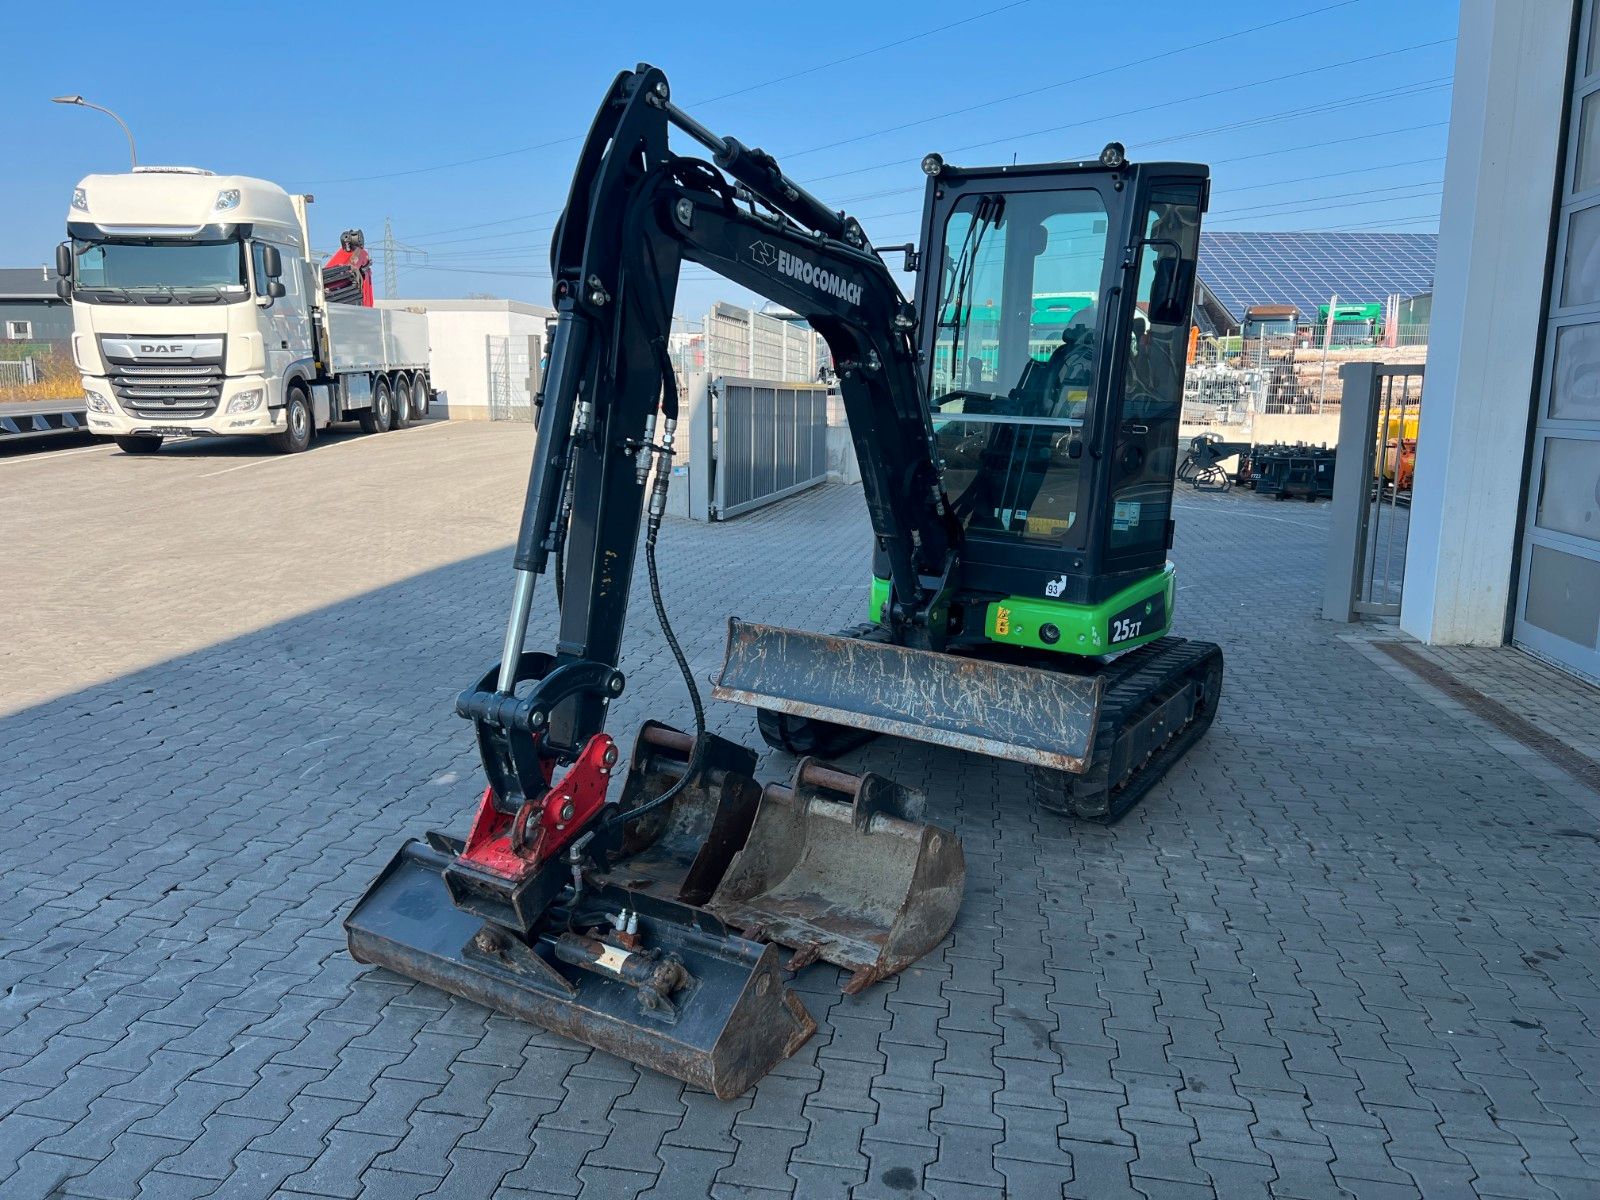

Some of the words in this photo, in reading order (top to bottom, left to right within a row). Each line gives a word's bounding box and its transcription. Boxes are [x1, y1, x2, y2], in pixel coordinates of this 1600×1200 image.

[777, 249, 862, 306] EUROCOMACH
[140, 345, 183, 353] DAF
[1048, 584, 1058, 594] 93
